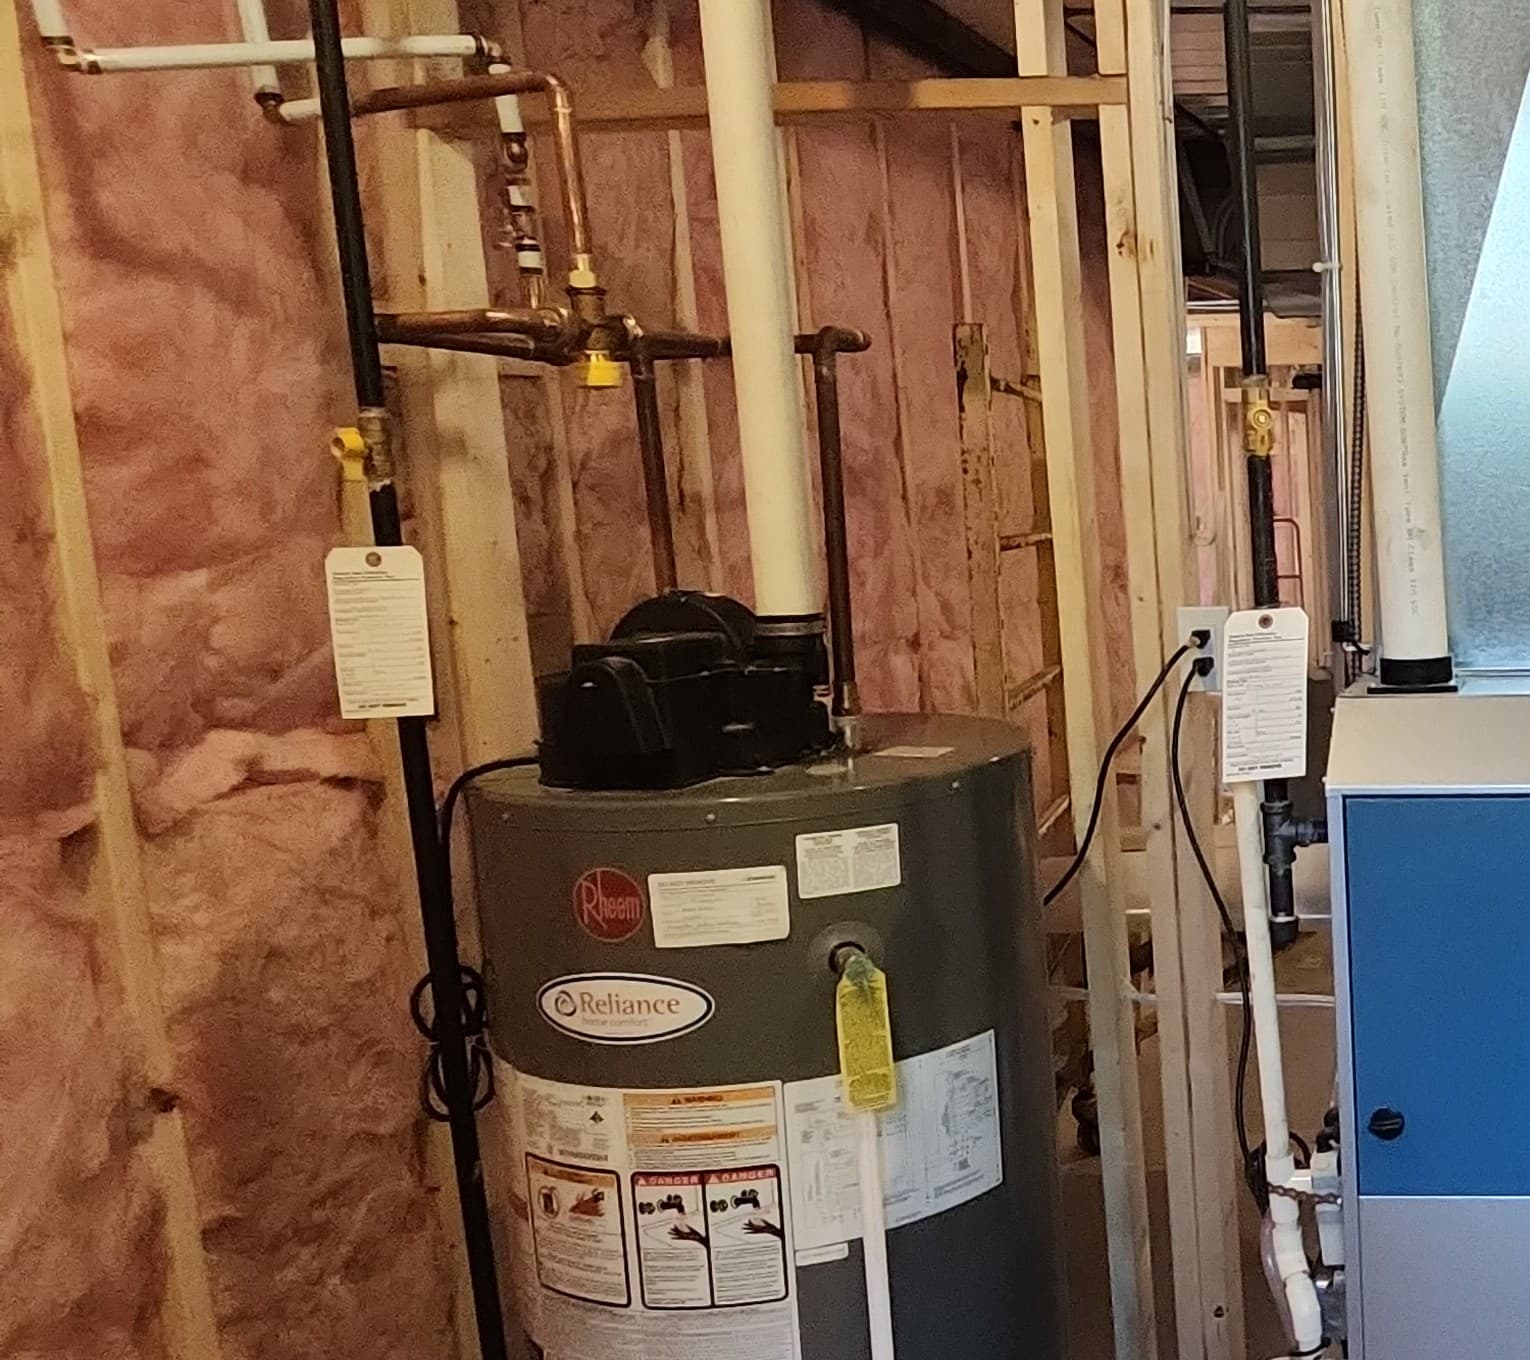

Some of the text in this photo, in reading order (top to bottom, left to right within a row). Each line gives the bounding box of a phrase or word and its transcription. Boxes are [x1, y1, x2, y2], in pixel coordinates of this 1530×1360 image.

[581, 870, 640, 928] Rheem
[580, 991, 681, 1016] Reliance
[648, 1175, 699, 1186] DANGER
[722, 1169, 775, 1184] DANGER
